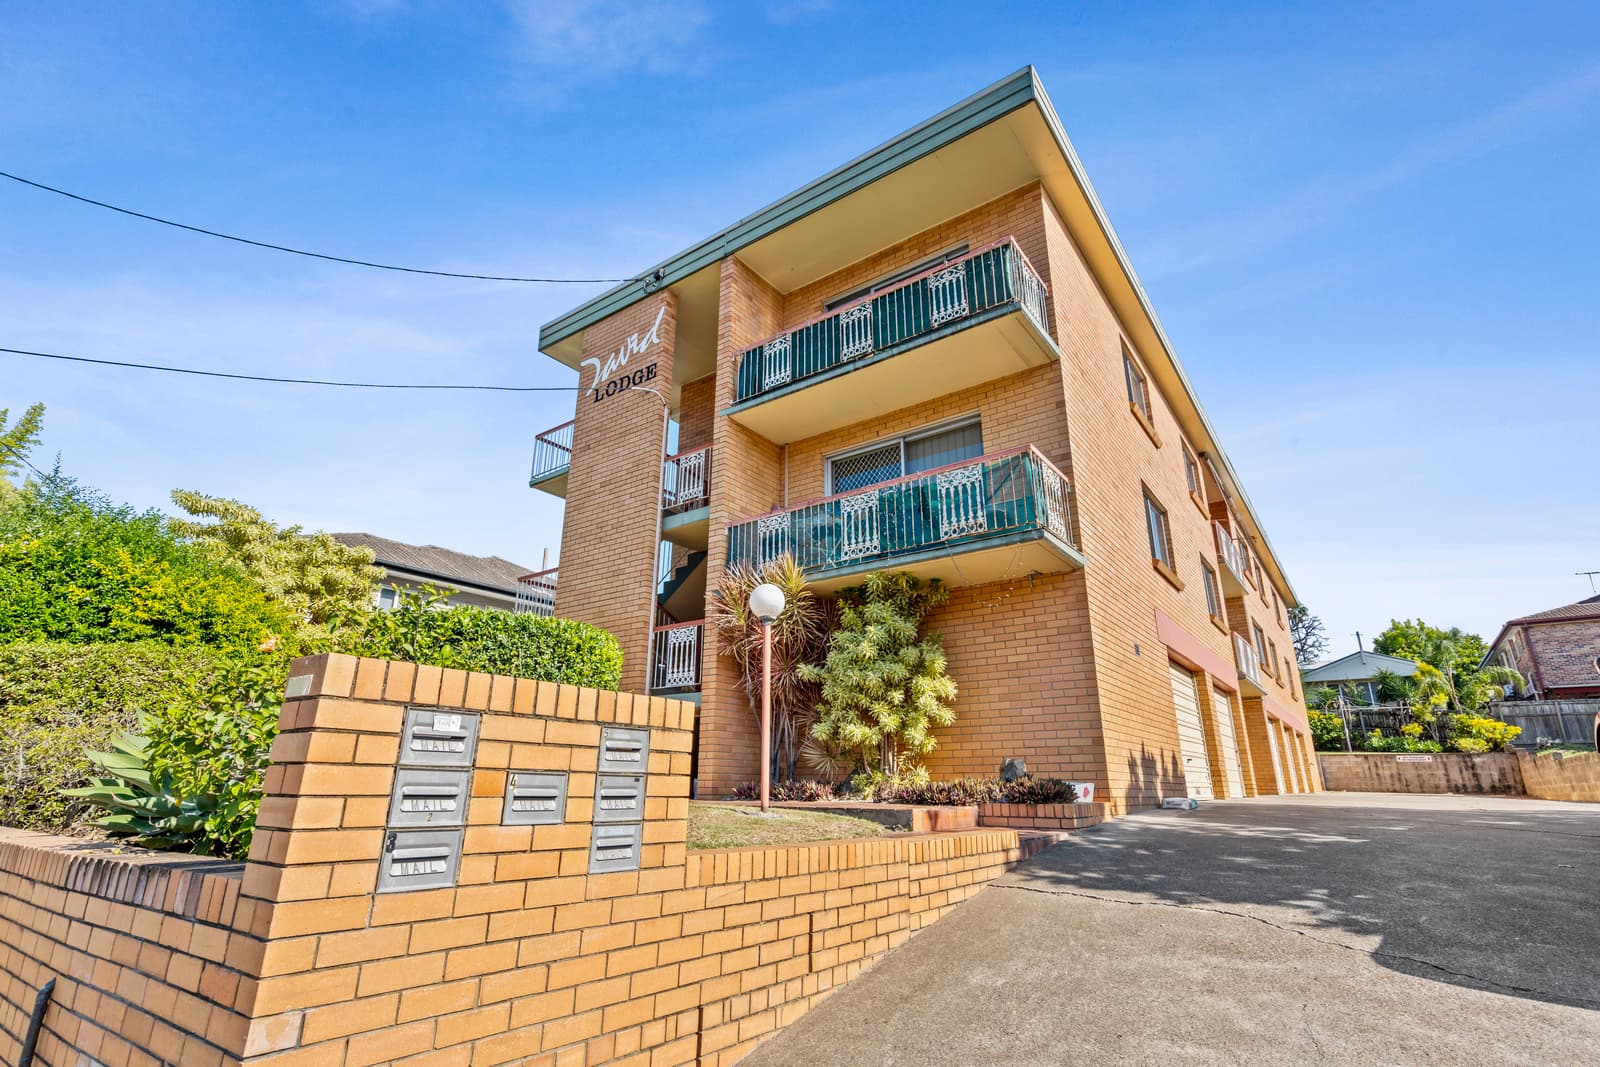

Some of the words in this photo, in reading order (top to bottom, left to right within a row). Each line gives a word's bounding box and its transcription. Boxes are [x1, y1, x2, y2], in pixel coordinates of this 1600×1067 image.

[593, 363, 657, 404] LODGE
[427, 812, 433, 822] 2
[386, 832, 398, 853] 3
[401, 860, 438, 875] MAIL
